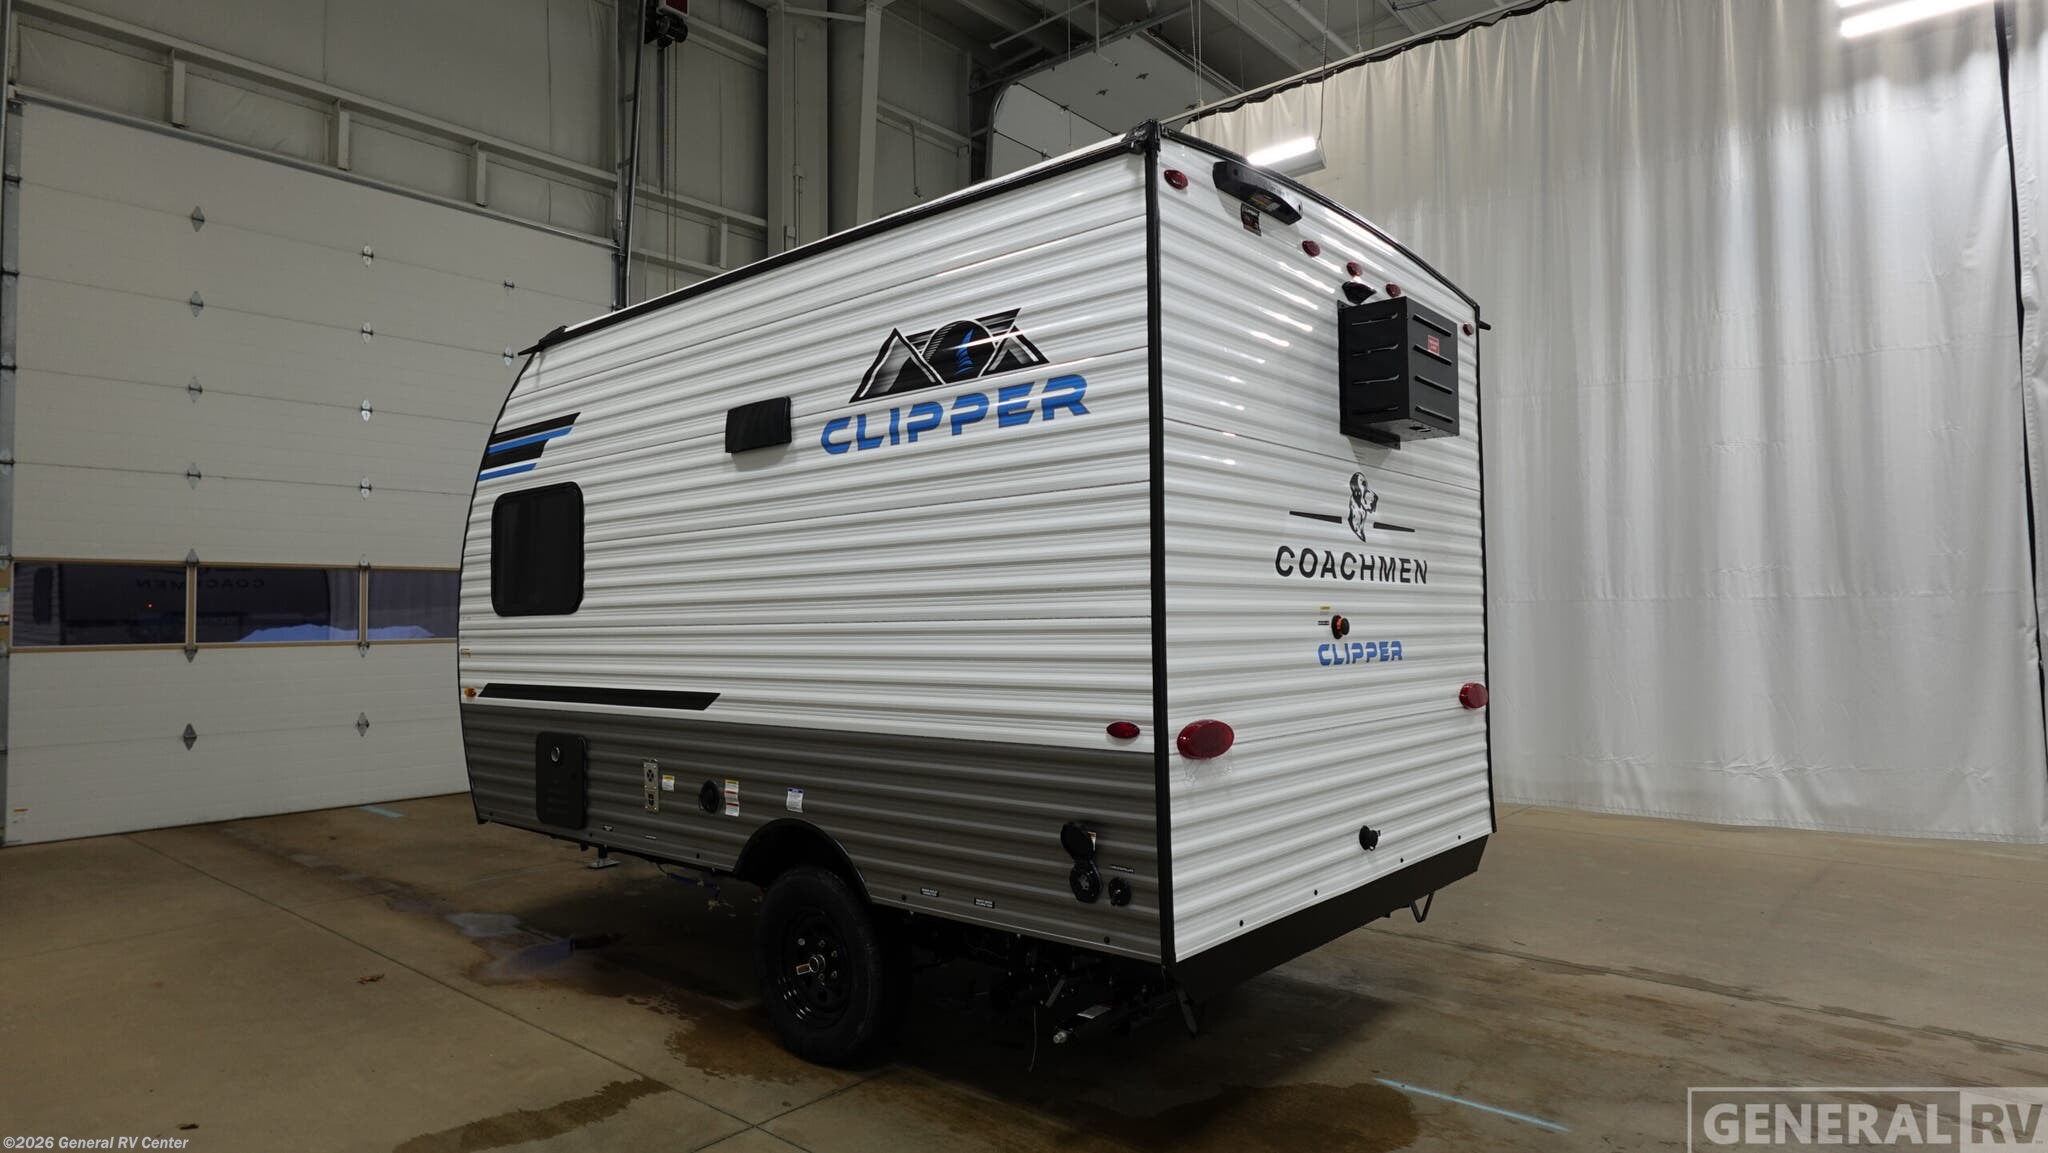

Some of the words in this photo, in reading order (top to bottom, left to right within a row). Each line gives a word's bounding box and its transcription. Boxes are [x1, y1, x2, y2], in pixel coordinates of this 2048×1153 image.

[820, 374, 1090, 455] CLIPPER
[1275, 545, 1428, 584] COACHMEN
[1317, 640, 1403, 666] CLIPPER
